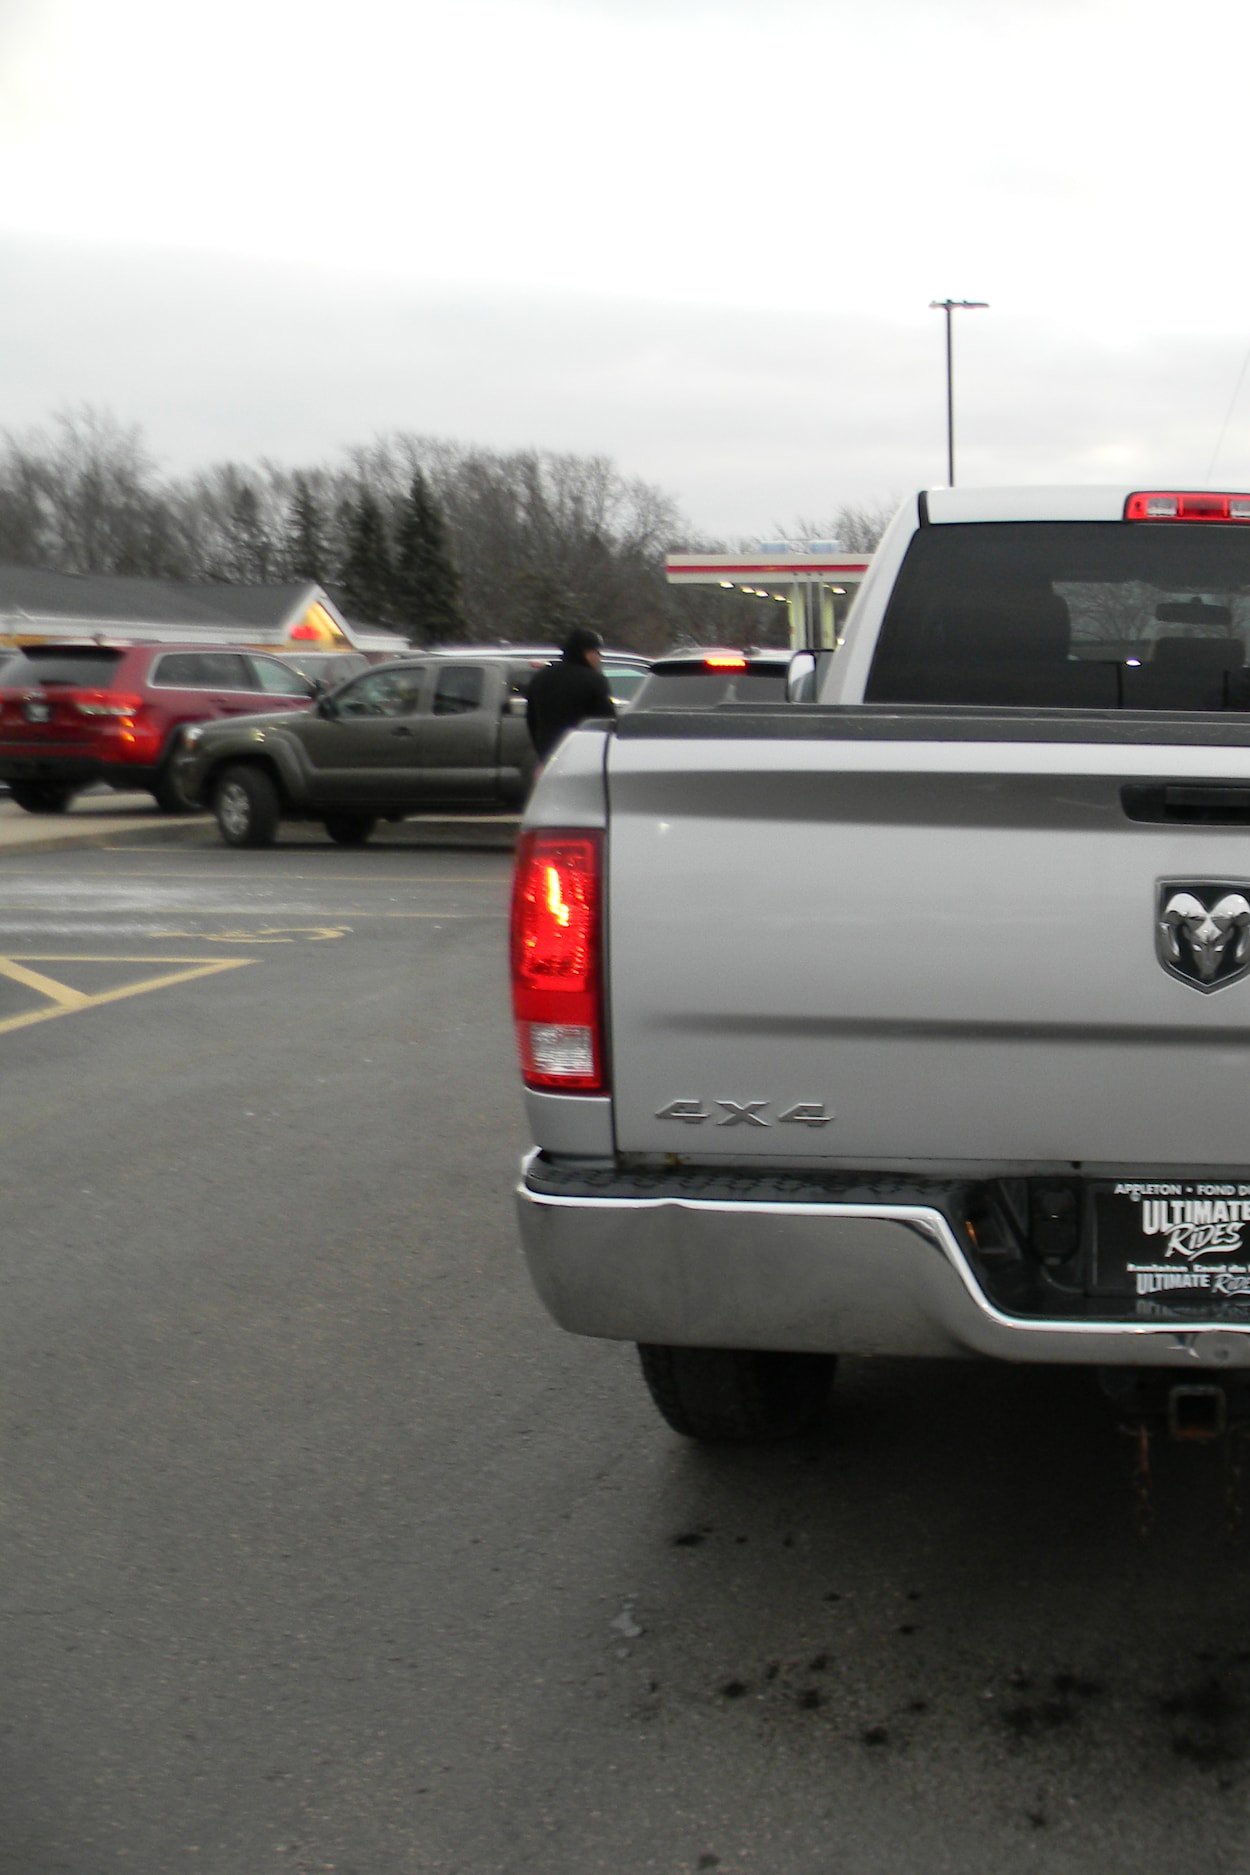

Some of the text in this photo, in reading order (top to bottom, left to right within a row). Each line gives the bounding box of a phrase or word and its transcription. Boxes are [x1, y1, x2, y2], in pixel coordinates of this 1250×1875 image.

[1114, 1184, 1182, 1196] APPLETON
[1197, 1185, 1236, 1197] FOND
[1136, 1274, 1211, 1295] ULTIMATE
